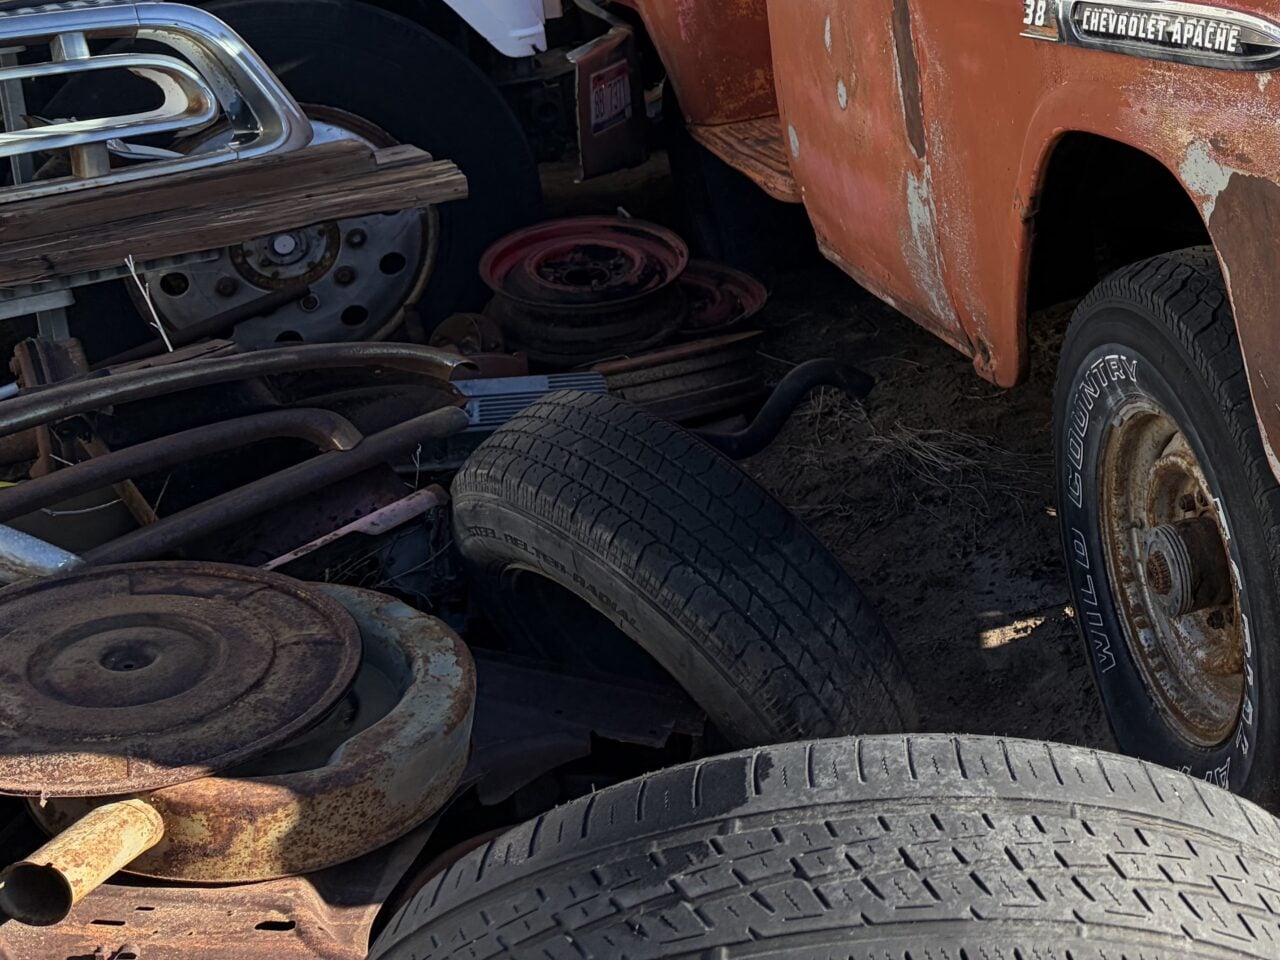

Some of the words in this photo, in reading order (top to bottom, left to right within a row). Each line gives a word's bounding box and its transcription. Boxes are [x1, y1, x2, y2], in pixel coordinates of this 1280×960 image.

[1082, 7, 1167, 41] CHEVROLET
[1171, 16, 1241, 52] APACHE
[1066, 354, 1139, 509] COUNTRY
[1071, 527, 1117, 674] WILD
